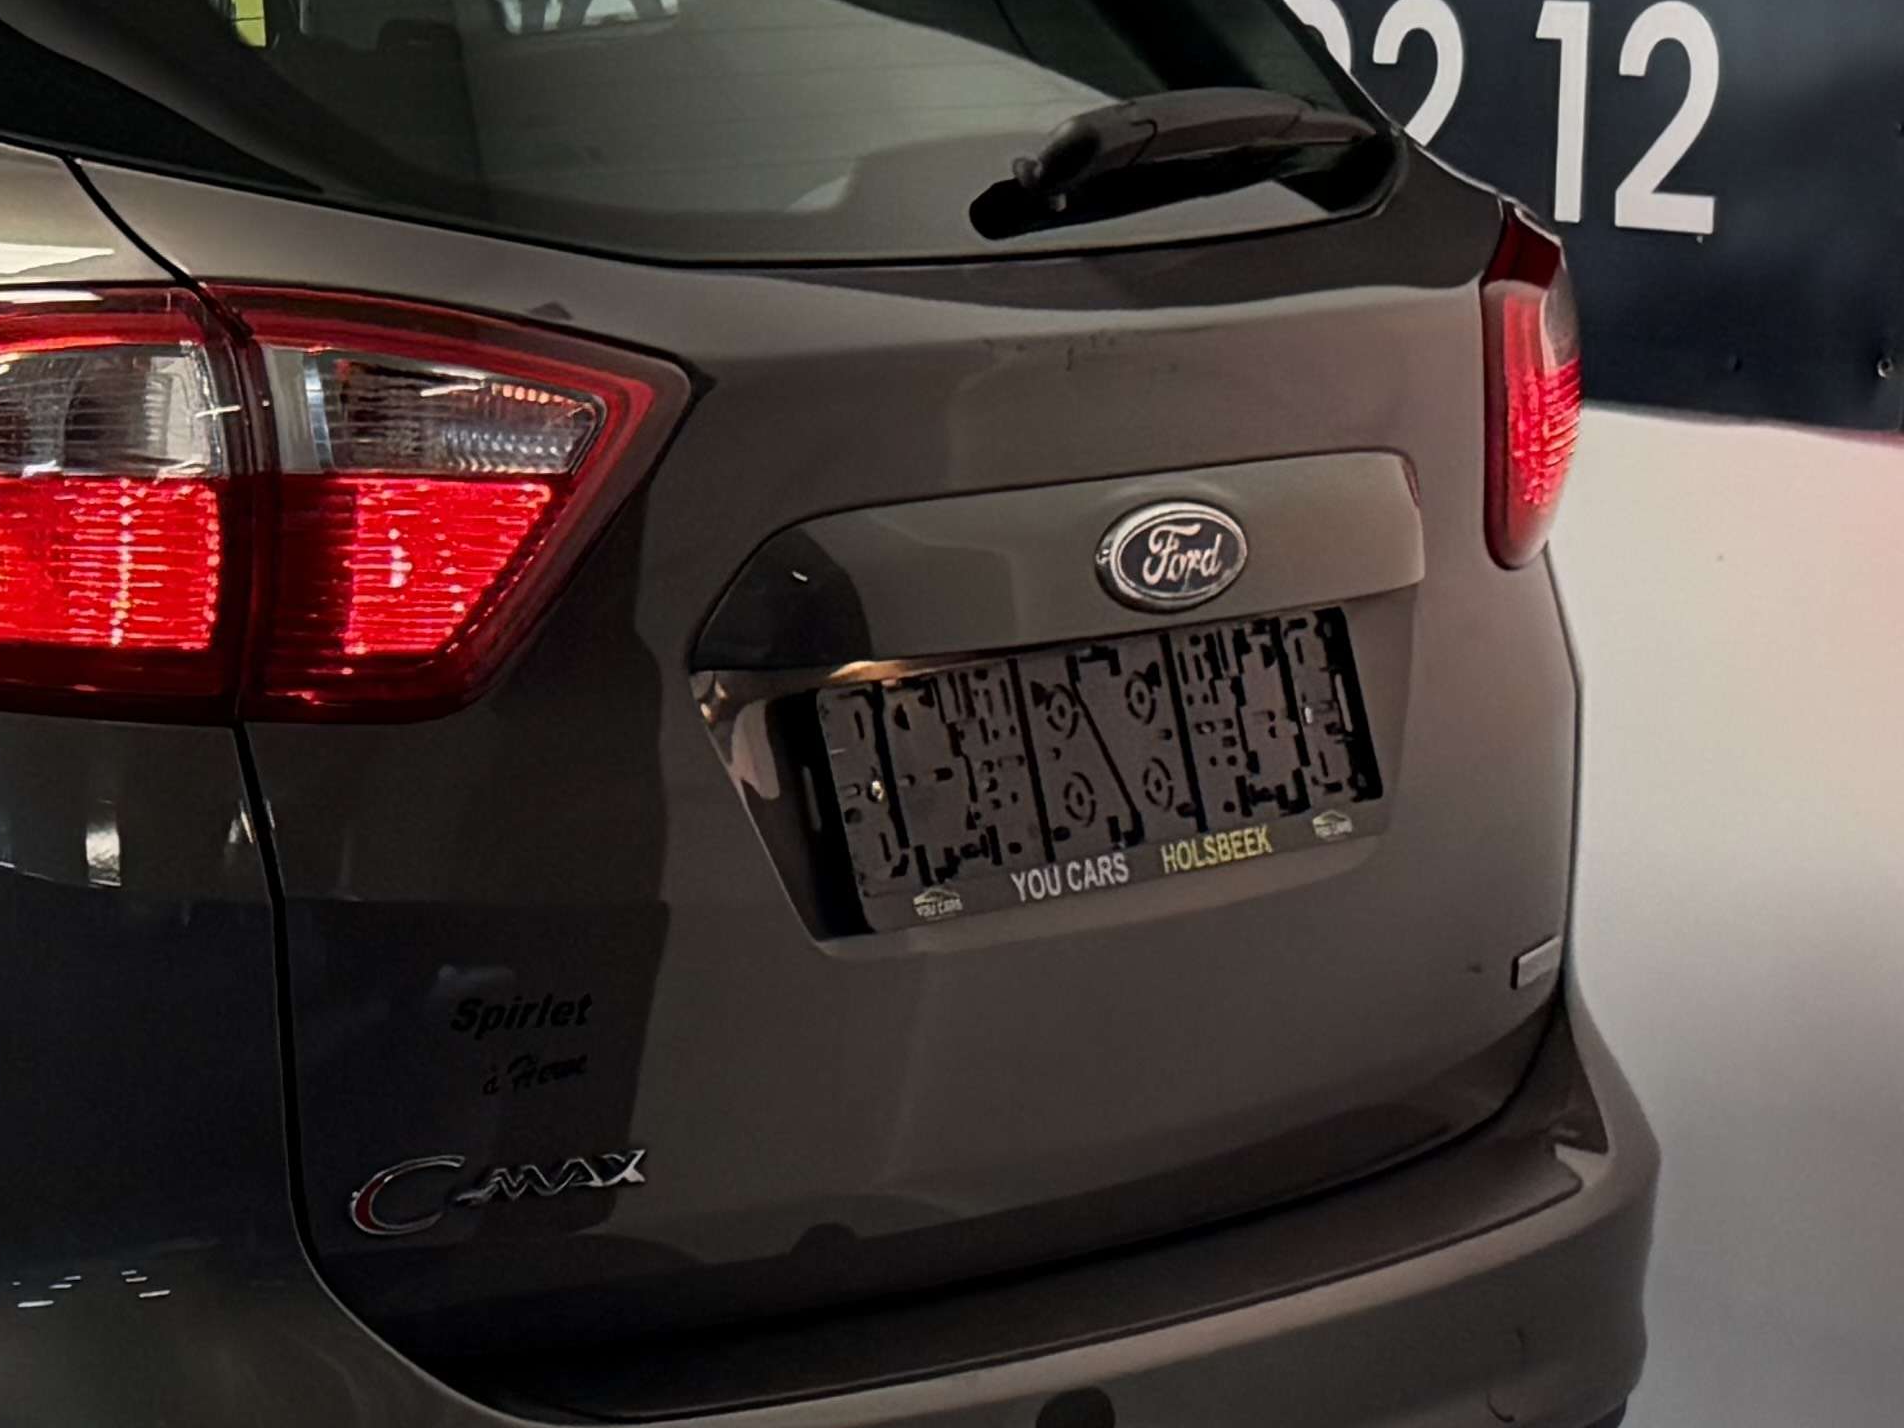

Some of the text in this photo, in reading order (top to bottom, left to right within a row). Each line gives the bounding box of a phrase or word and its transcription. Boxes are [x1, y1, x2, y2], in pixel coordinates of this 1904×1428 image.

[1535, 0, 1721, 236] 12
[1141, 522, 1224, 588] Ford
[1010, 871, 1062, 903] YOU
[1066, 852, 1130, 893] CARS
[1160, 824, 1273, 874] HOLSBEEK
[448, 992, 593, 1041] Spirlet
